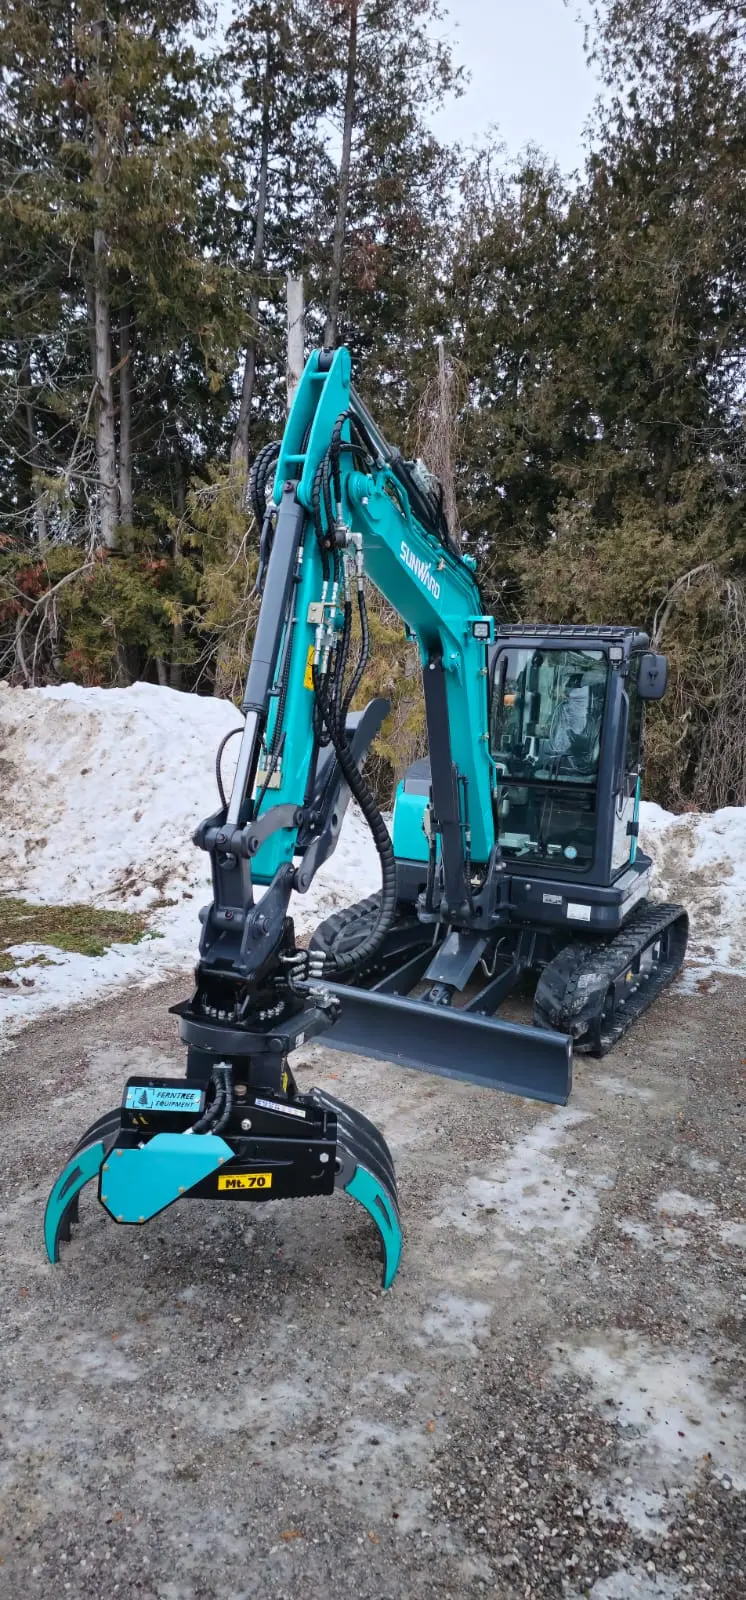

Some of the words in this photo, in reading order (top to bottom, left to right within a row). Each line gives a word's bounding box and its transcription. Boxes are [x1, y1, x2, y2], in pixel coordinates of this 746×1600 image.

[400, 540, 440, 600] SUNWARD
[156, 1091, 196, 1100] FERNTREE
[155, 1100, 195, 1108] EQUIPMENT
[225, 1179, 246, 1188] Mt.
[247, 1176, 266, 1188] 70
